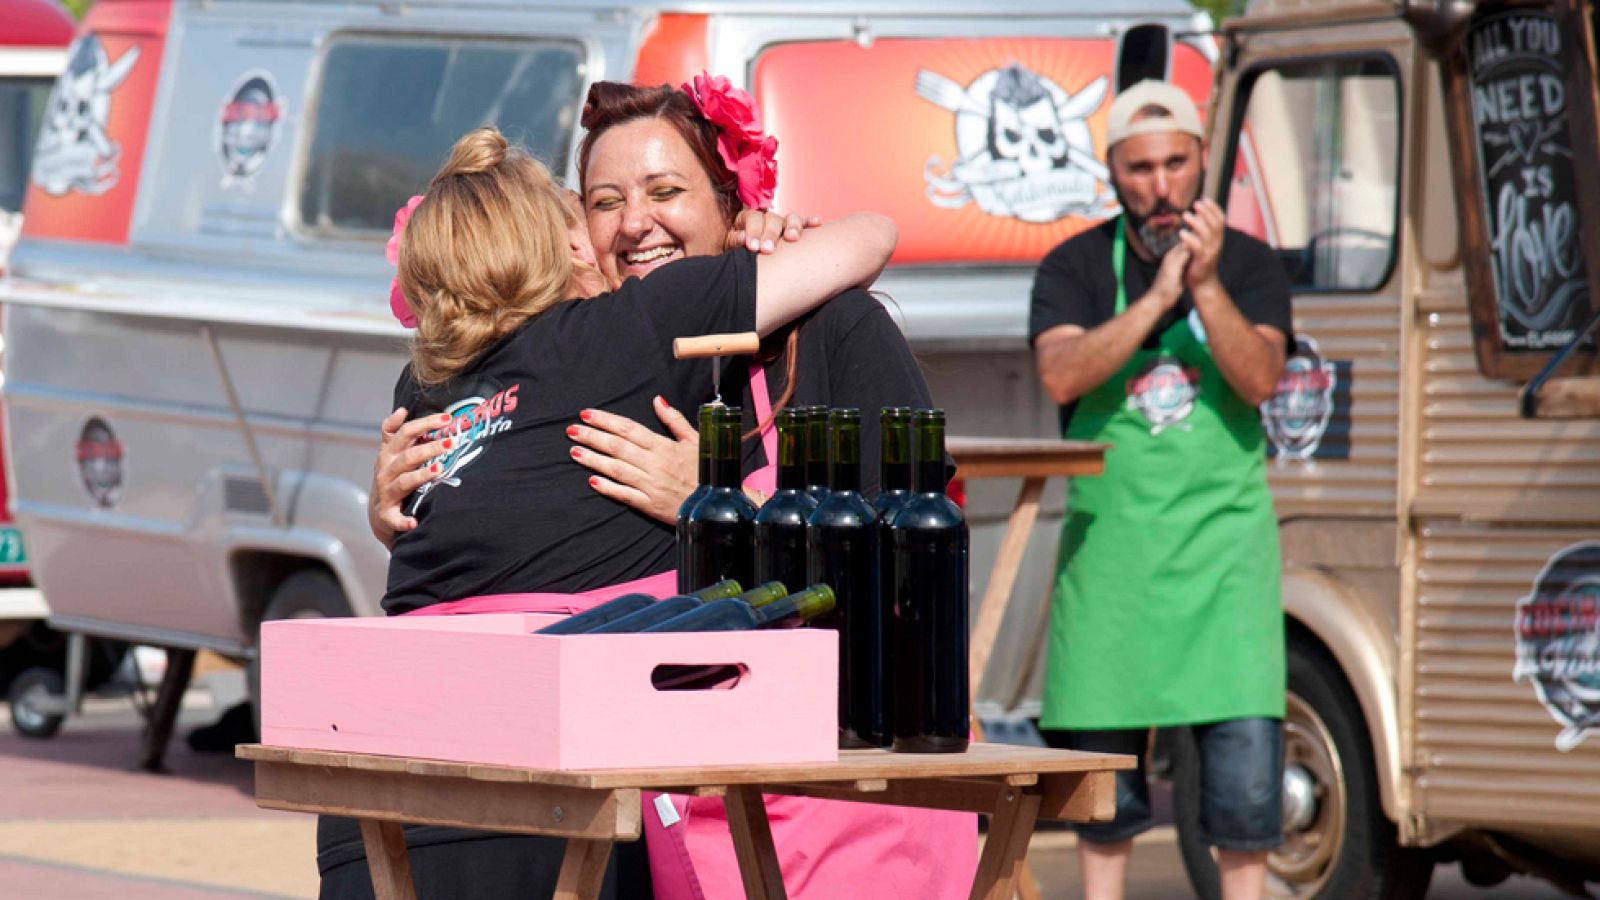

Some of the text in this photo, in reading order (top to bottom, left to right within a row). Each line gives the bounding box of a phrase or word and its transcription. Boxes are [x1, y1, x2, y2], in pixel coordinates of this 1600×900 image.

[1508, 17, 1561, 55] YOU
[1475, 74, 1565, 125] NEED
[1520, 165, 1554, 197] IS
